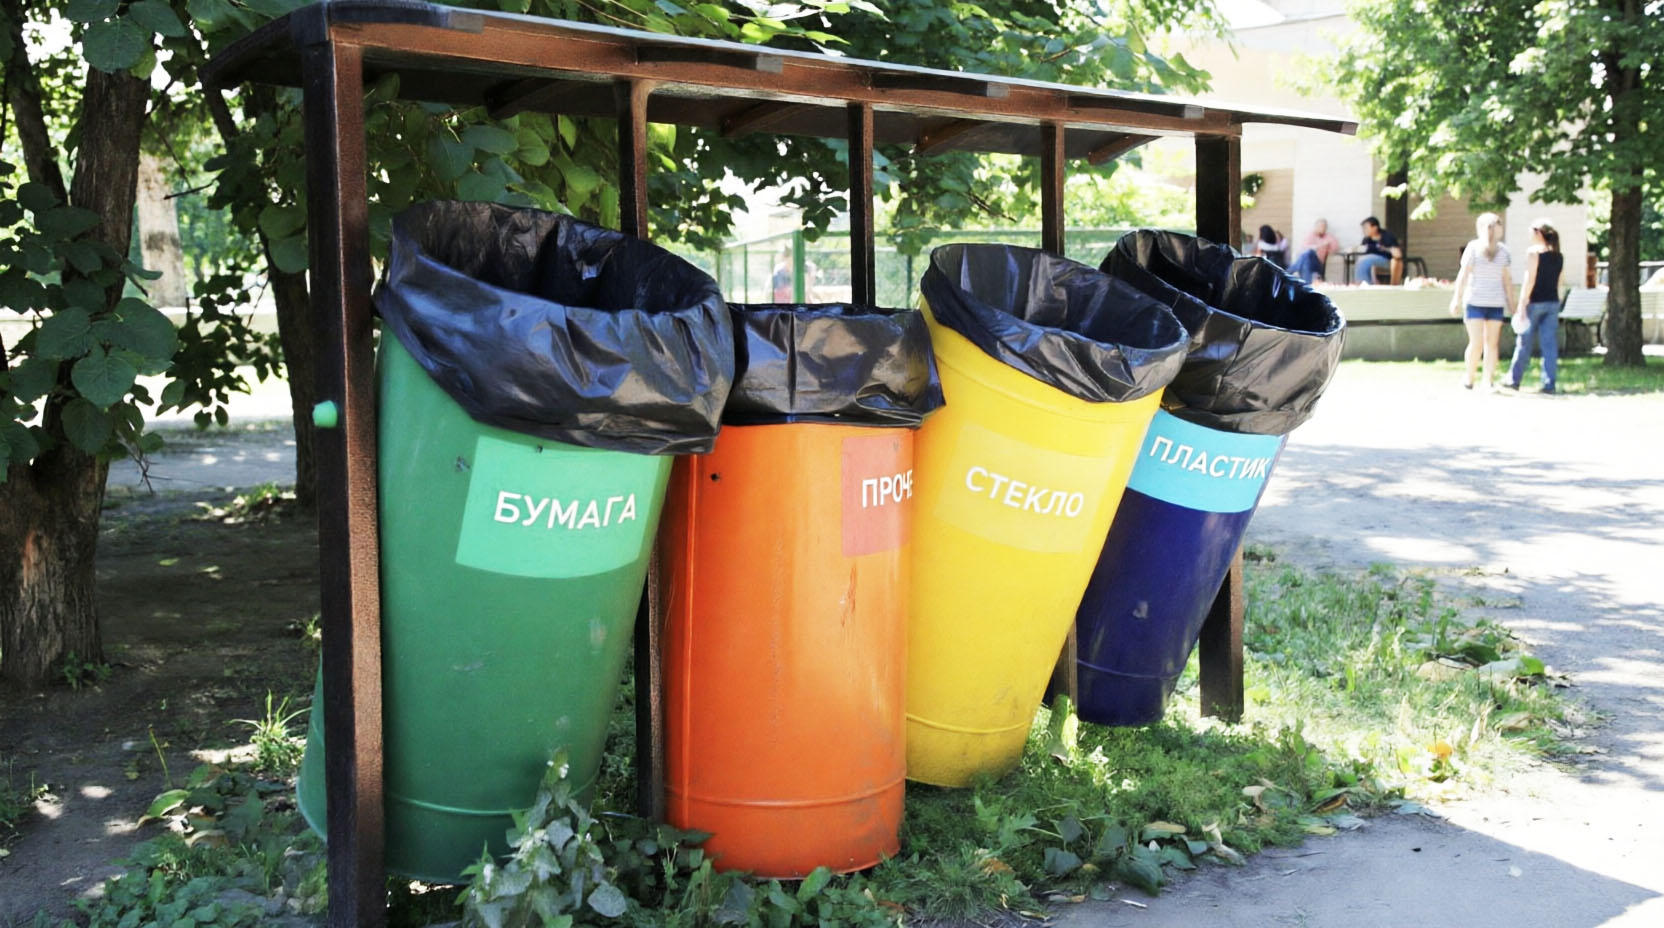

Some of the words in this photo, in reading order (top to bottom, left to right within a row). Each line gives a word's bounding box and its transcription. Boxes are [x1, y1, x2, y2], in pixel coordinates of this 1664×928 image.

[1150, 436, 1269, 479] ПЛАСТИК
[493, 490, 636, 529] БУМАГА
[965, 466, 1084, 517] СТЕКЛО
